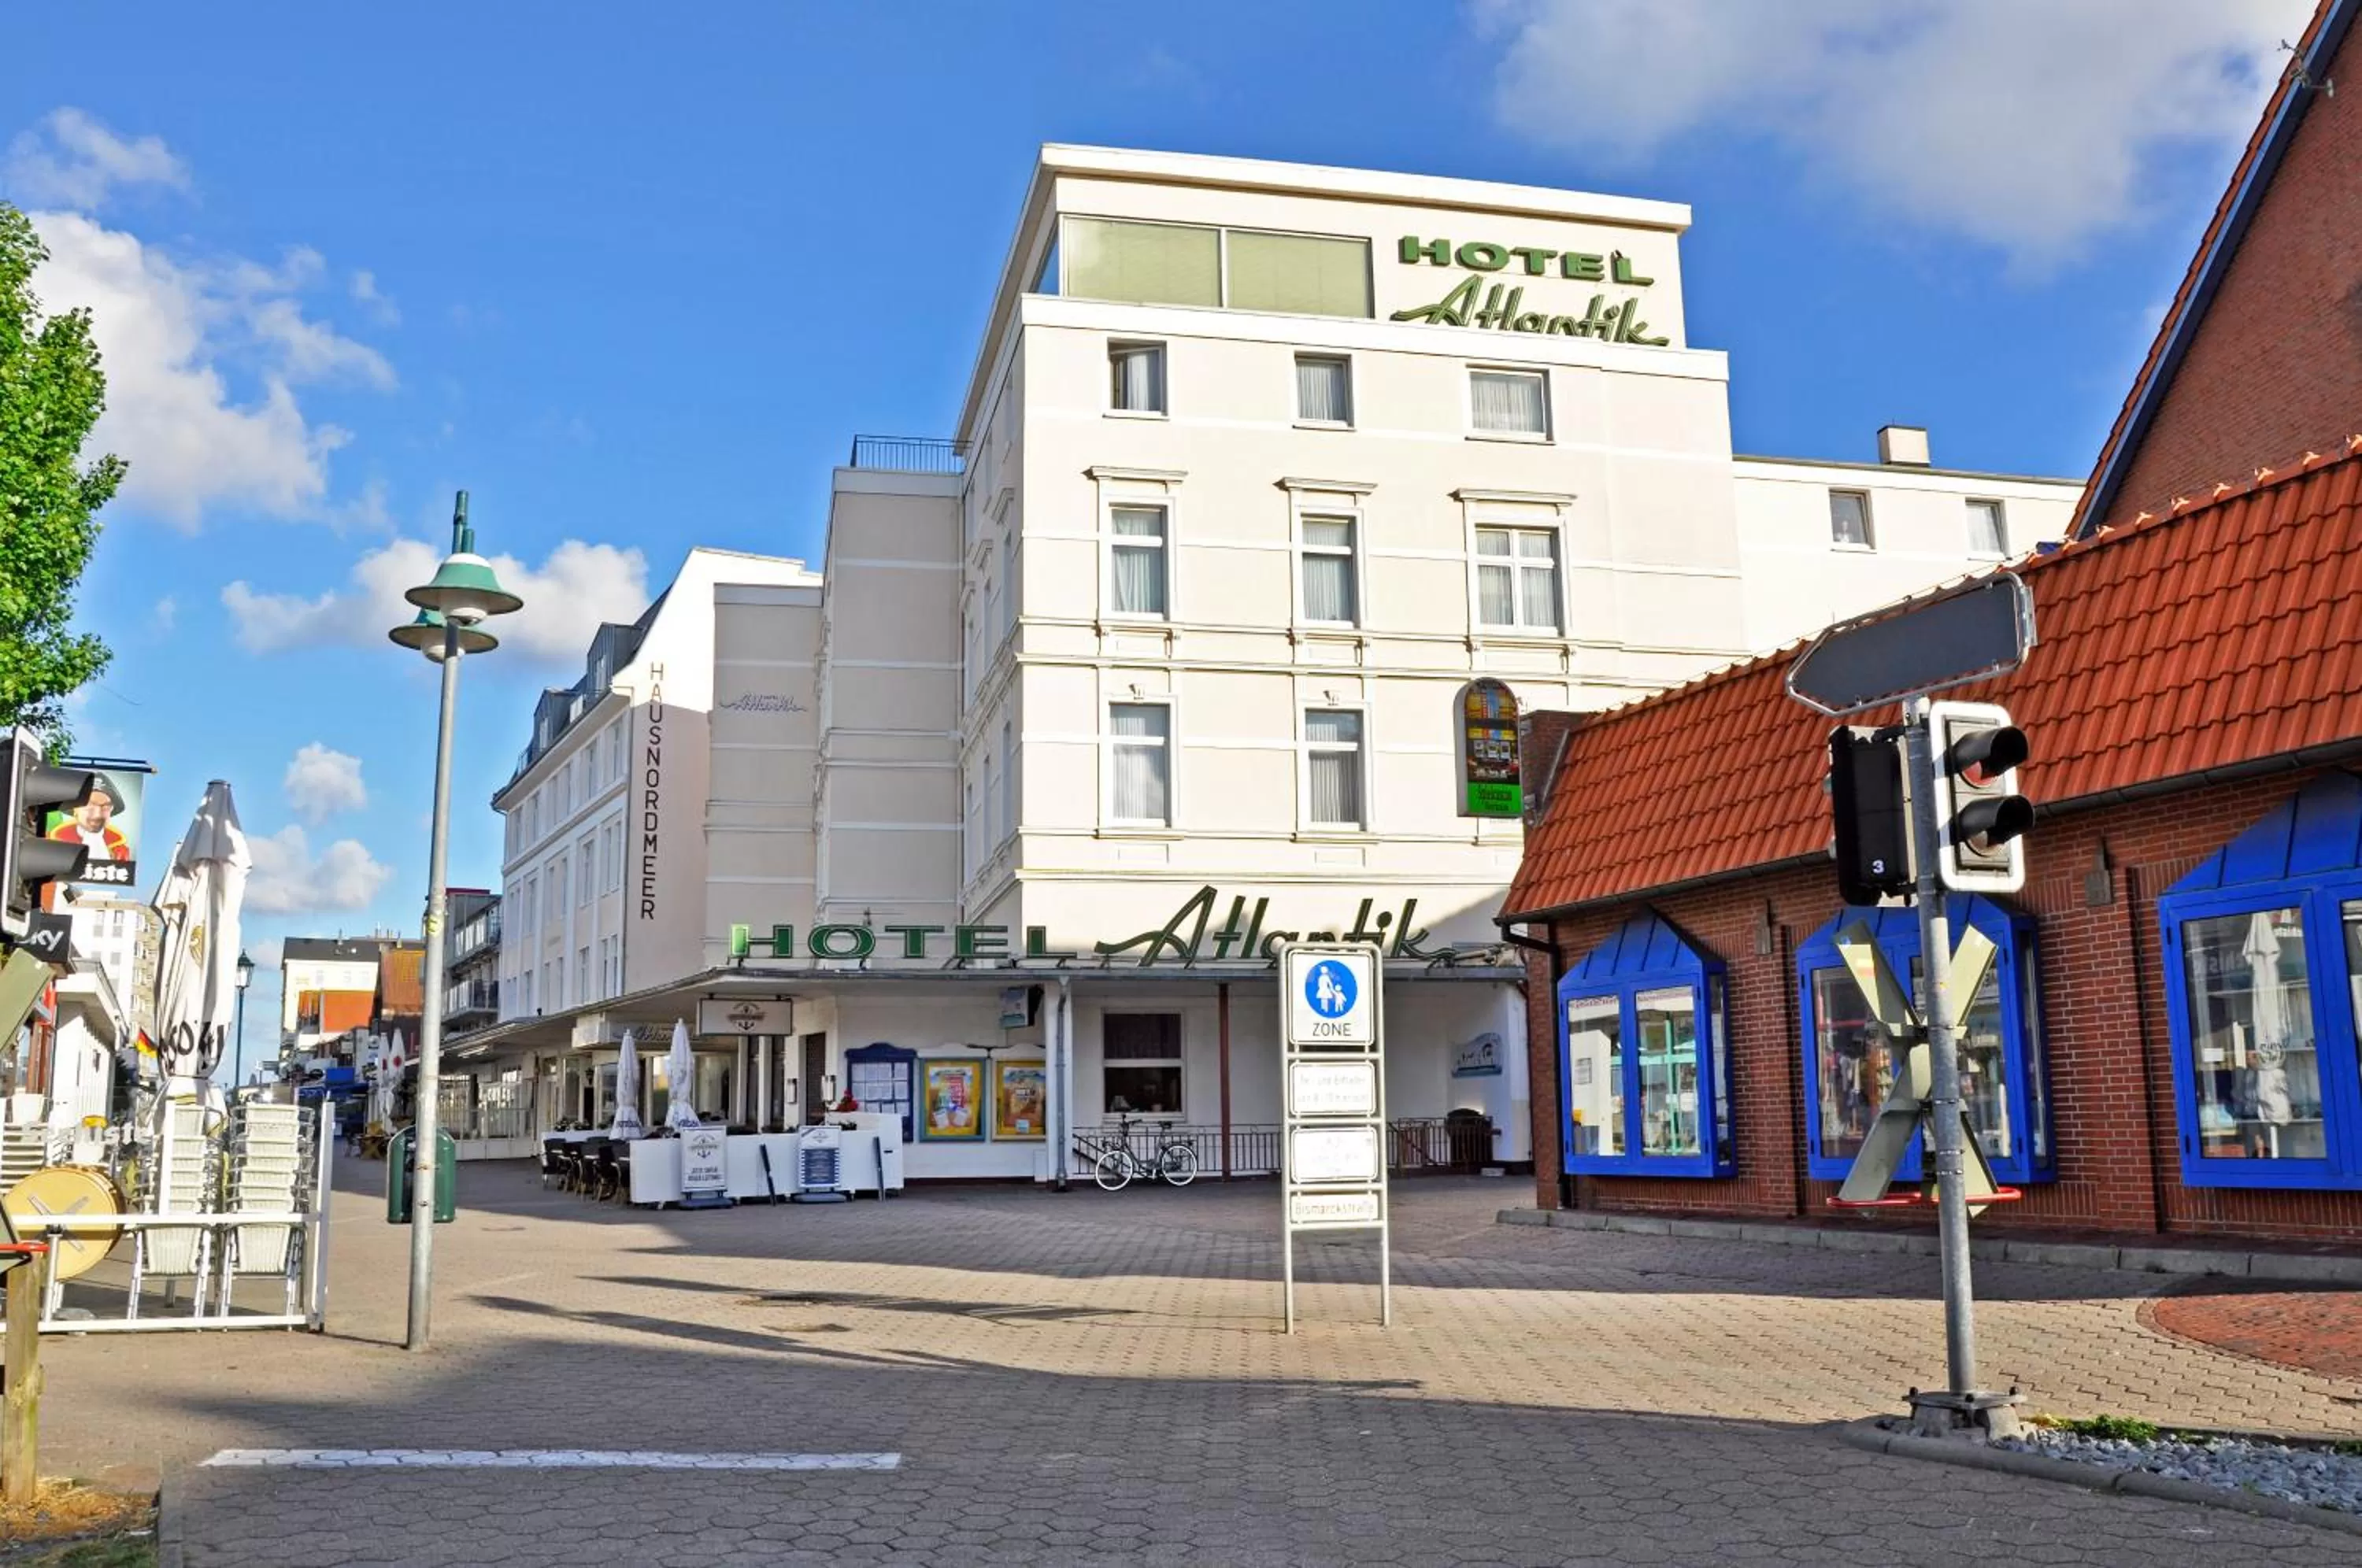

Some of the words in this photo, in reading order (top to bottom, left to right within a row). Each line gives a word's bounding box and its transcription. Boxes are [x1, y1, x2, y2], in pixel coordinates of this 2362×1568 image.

[1398, 236, 1654, 286] HOTEL
[1390, 272, 1670, 347] Atlantik
[79, 863, 129, 882] iste
[1872, 860, 1884, 874] 3
[1094, 885, 1457, 967] Atlantik
[25, 930, 64, 952] ky
[730, 923, 1077, 960] HOTEL
[1312, 1022, 1352, 1037] ZONE
